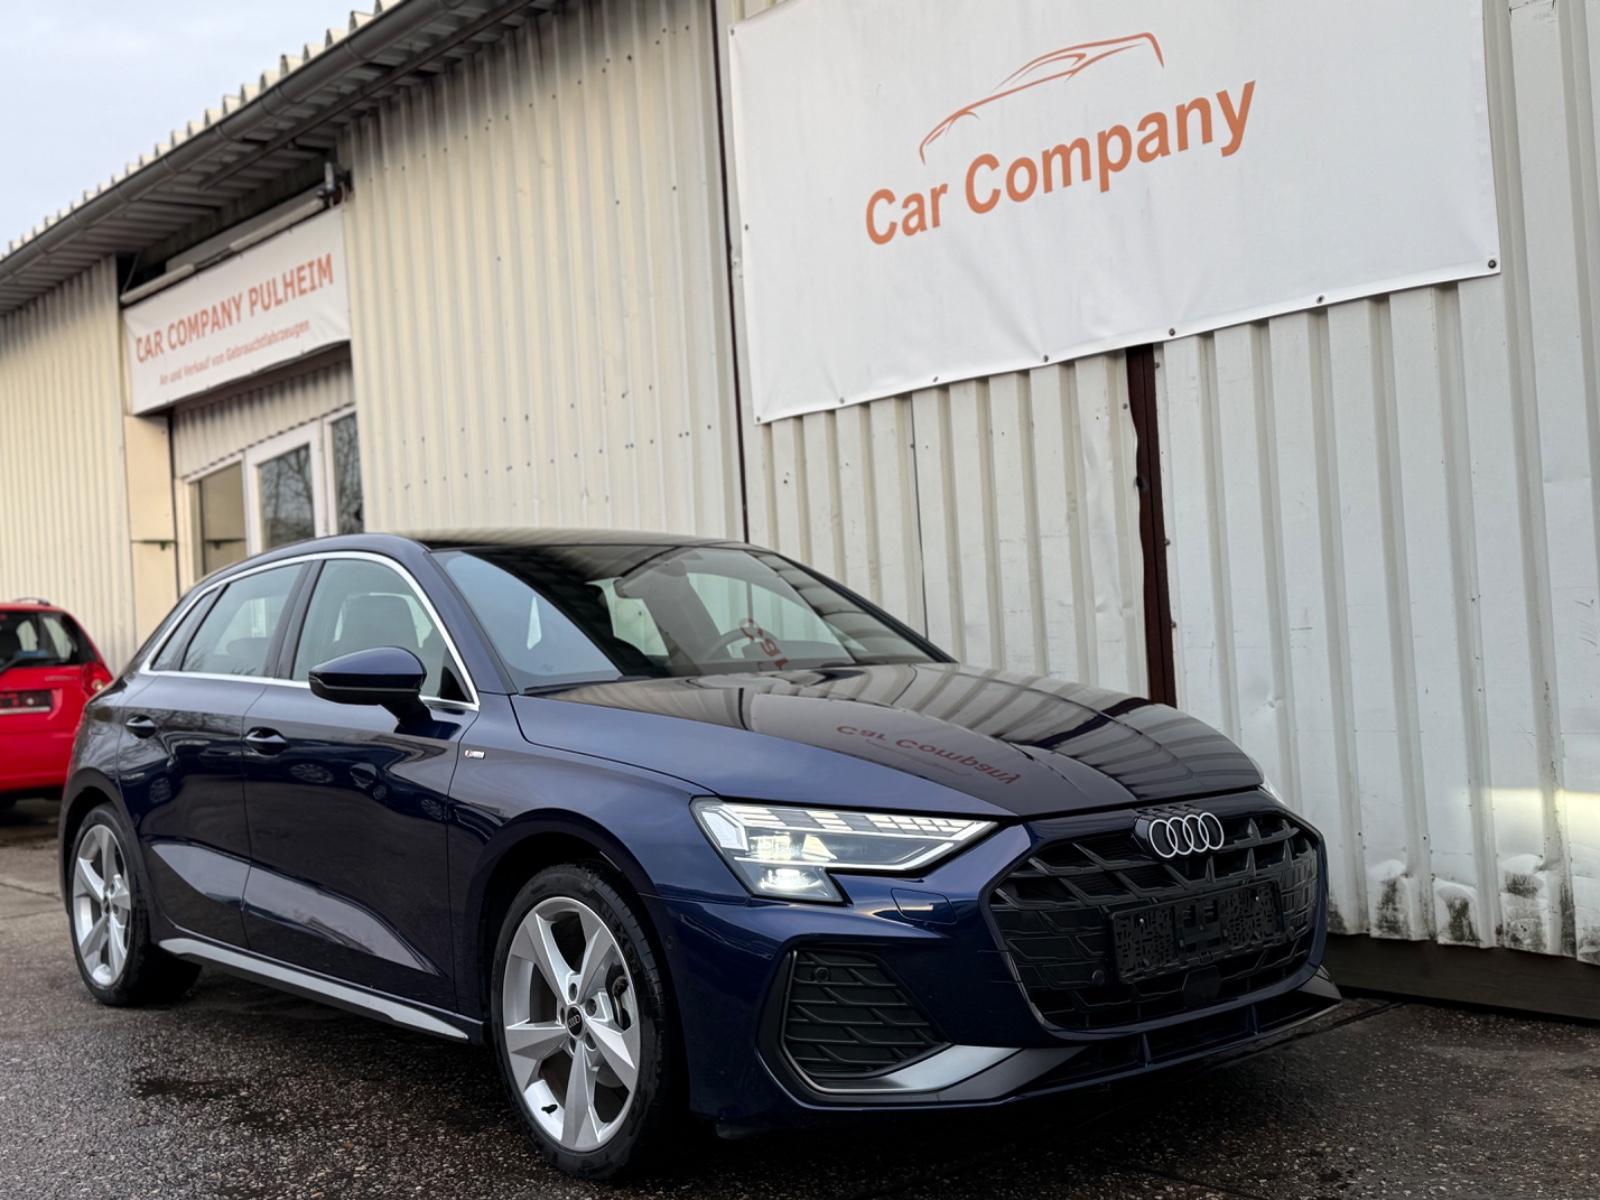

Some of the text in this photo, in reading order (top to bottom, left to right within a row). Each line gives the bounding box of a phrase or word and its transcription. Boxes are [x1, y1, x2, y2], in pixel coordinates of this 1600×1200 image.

[865, 80, 1256, 246] Car Company
[135, 253, 334, 363] CAR COMPANY PULHEIM
